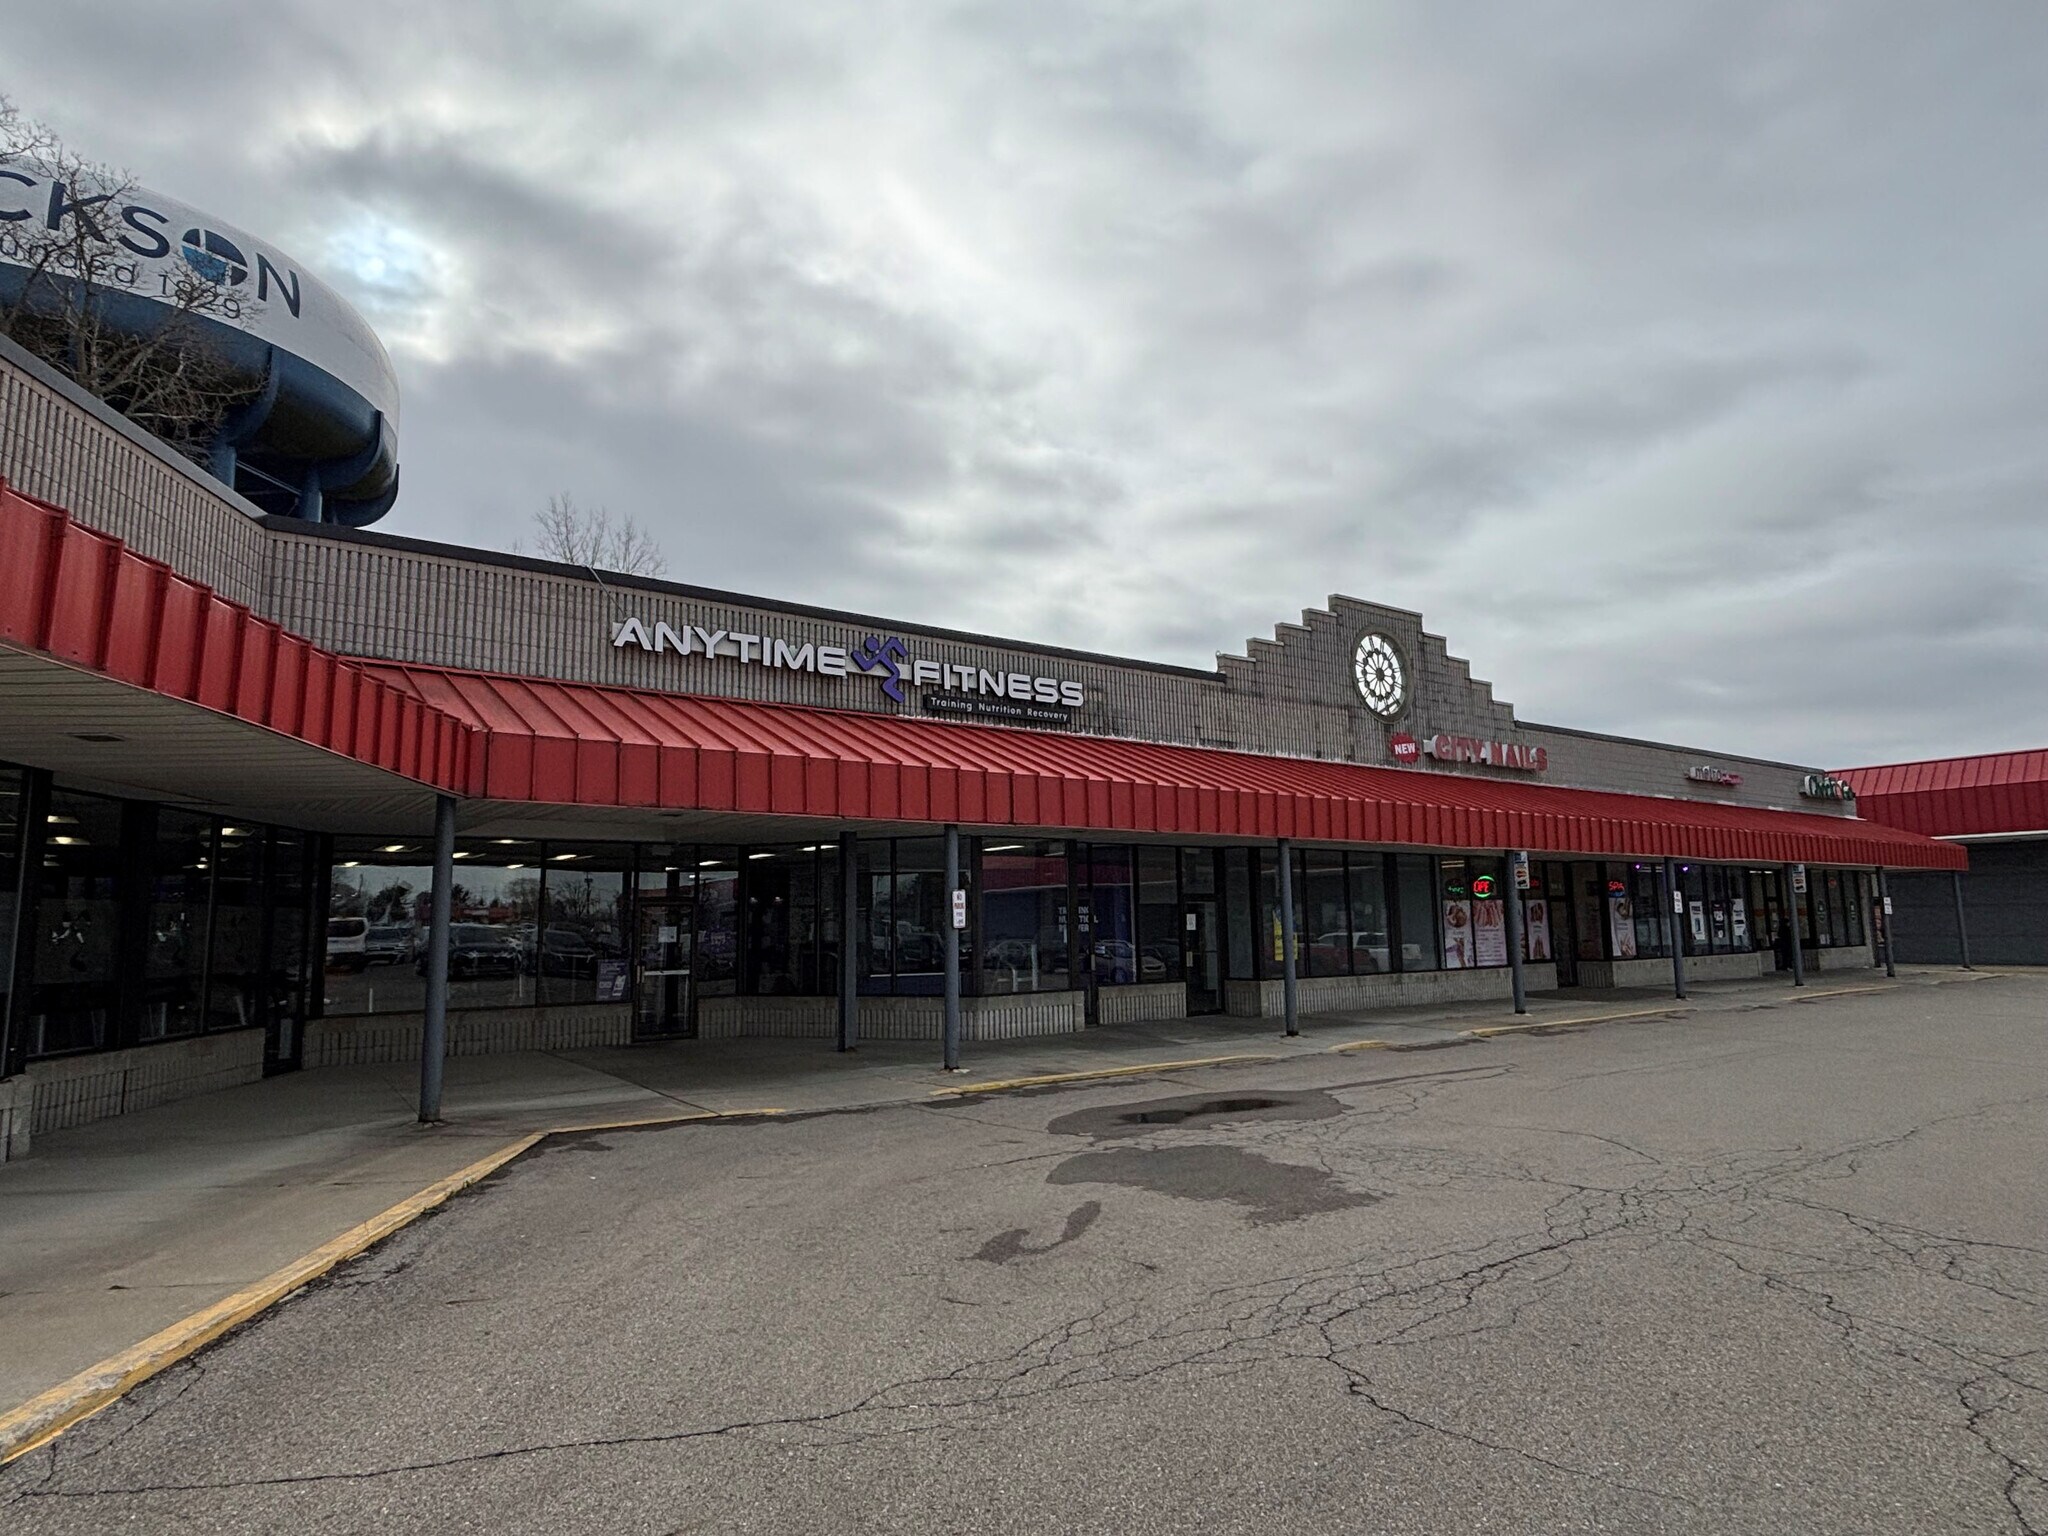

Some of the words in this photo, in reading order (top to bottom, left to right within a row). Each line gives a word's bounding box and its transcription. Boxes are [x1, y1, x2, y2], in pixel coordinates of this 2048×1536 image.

[613, 617, 847, 677] ANYTIME
[912, 659, 1084, 707] FITNESS
[931, 697, 973, 712] Training
[978, 702, 1022, 716] Nutrition
[1027, 707, 1068, 722] Recovery
[1394, 743, 1416, 755] NEW
[1434, 735, 1485, 763] CITY
[1487, 741, 1548, 772] NAILS
